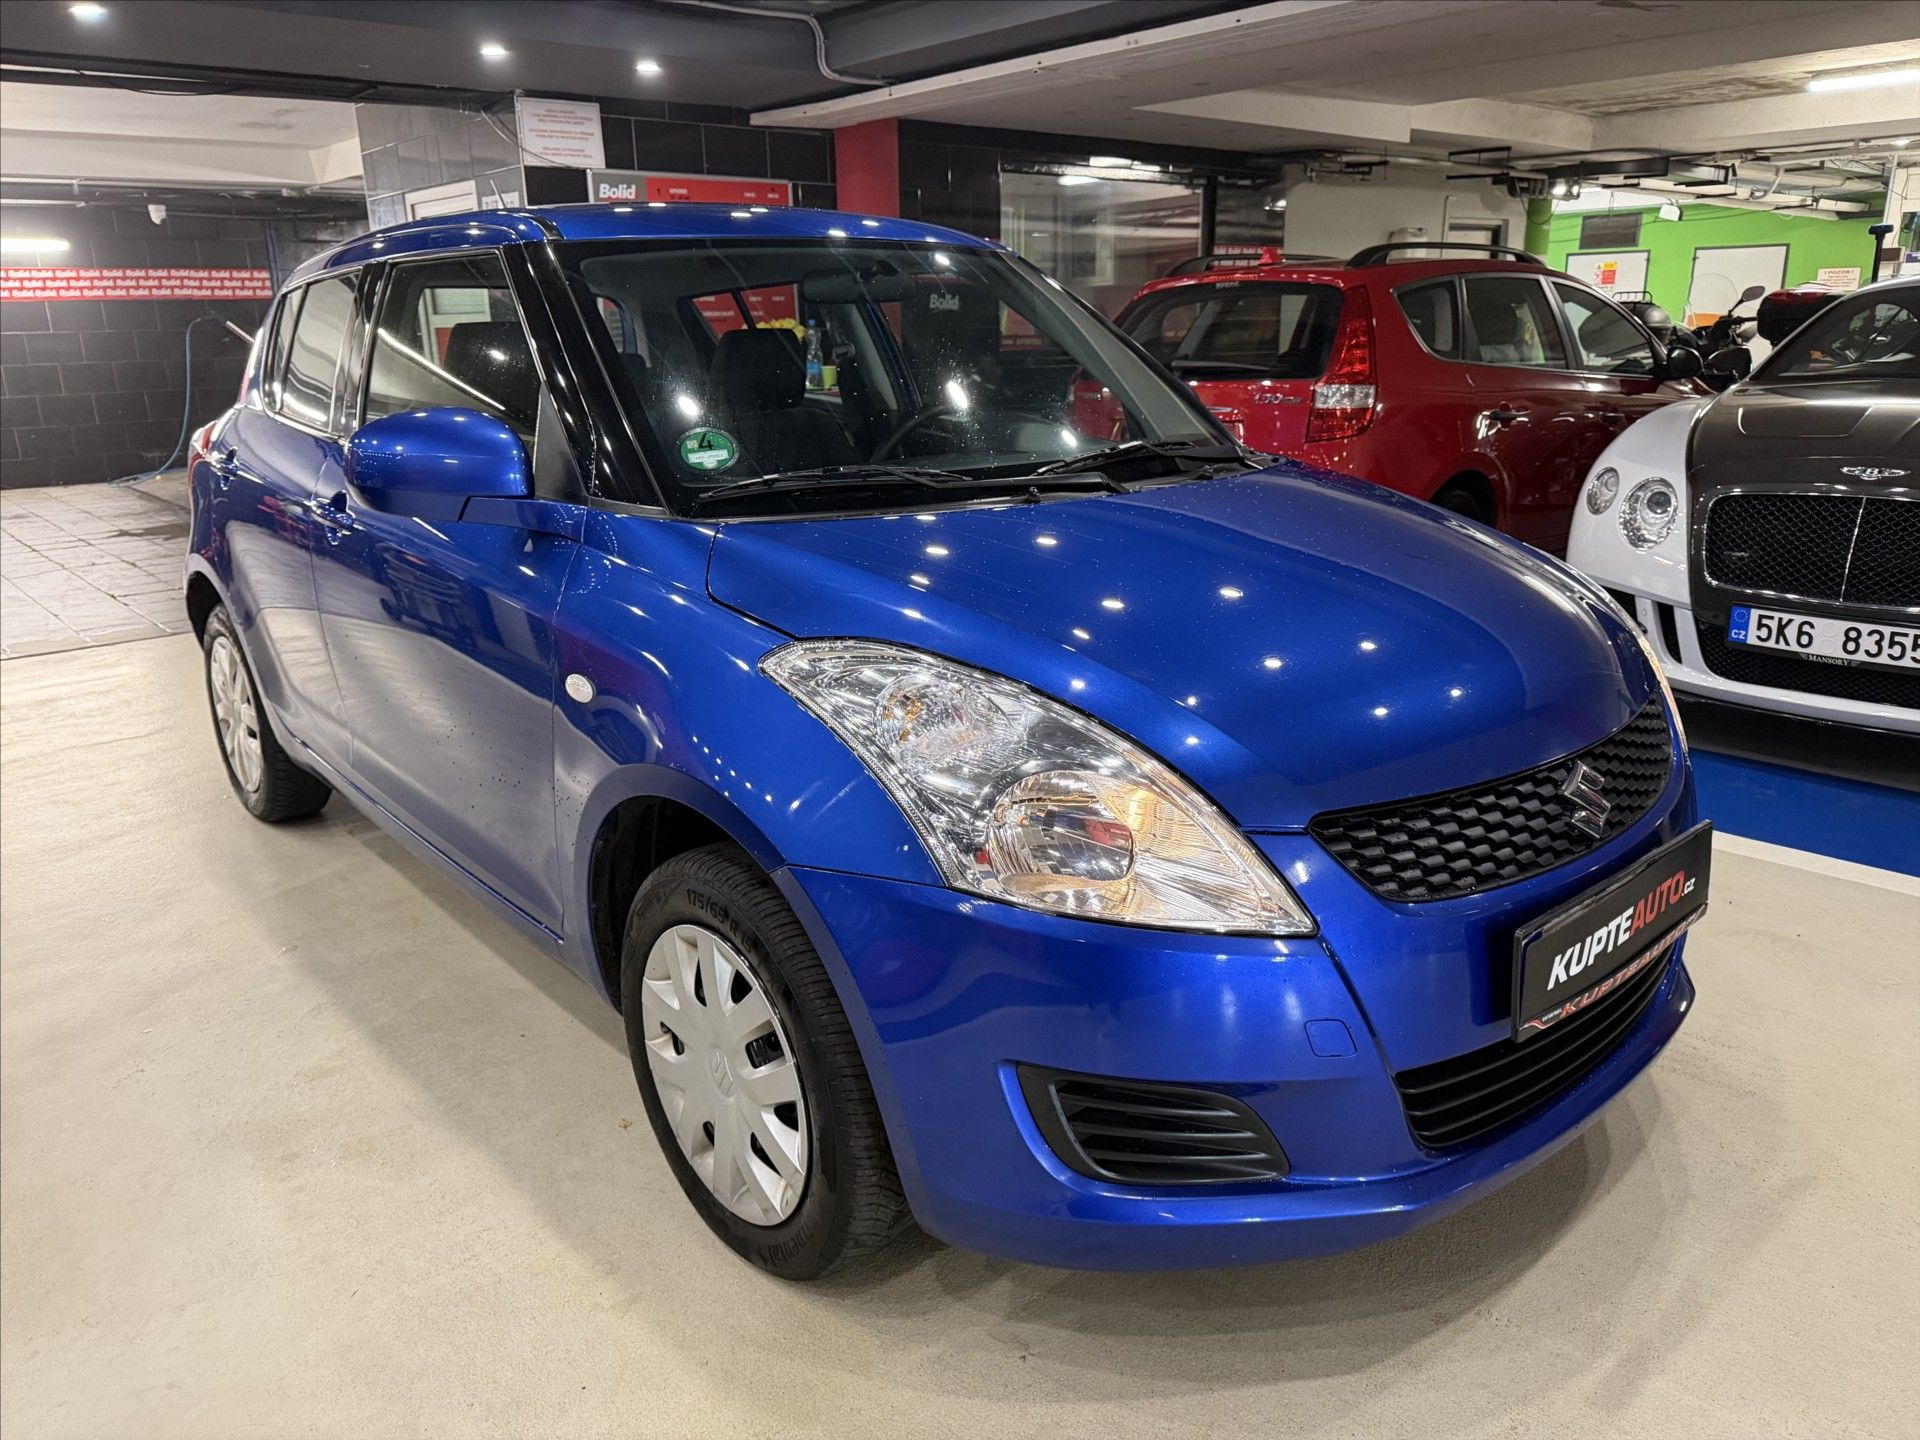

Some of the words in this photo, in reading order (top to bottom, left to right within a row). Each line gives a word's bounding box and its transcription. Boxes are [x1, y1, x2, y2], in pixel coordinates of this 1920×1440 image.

[599, 183, 636, 200] Bolid
[929, 294, 959, 309] Bolid
[699, 432, 714, 449] 4
[1731, 629, 1746, 640] CZ
[1755, 614, 1815, 649] 5K6
[1808, 654, 1850, 666] MANSORY
